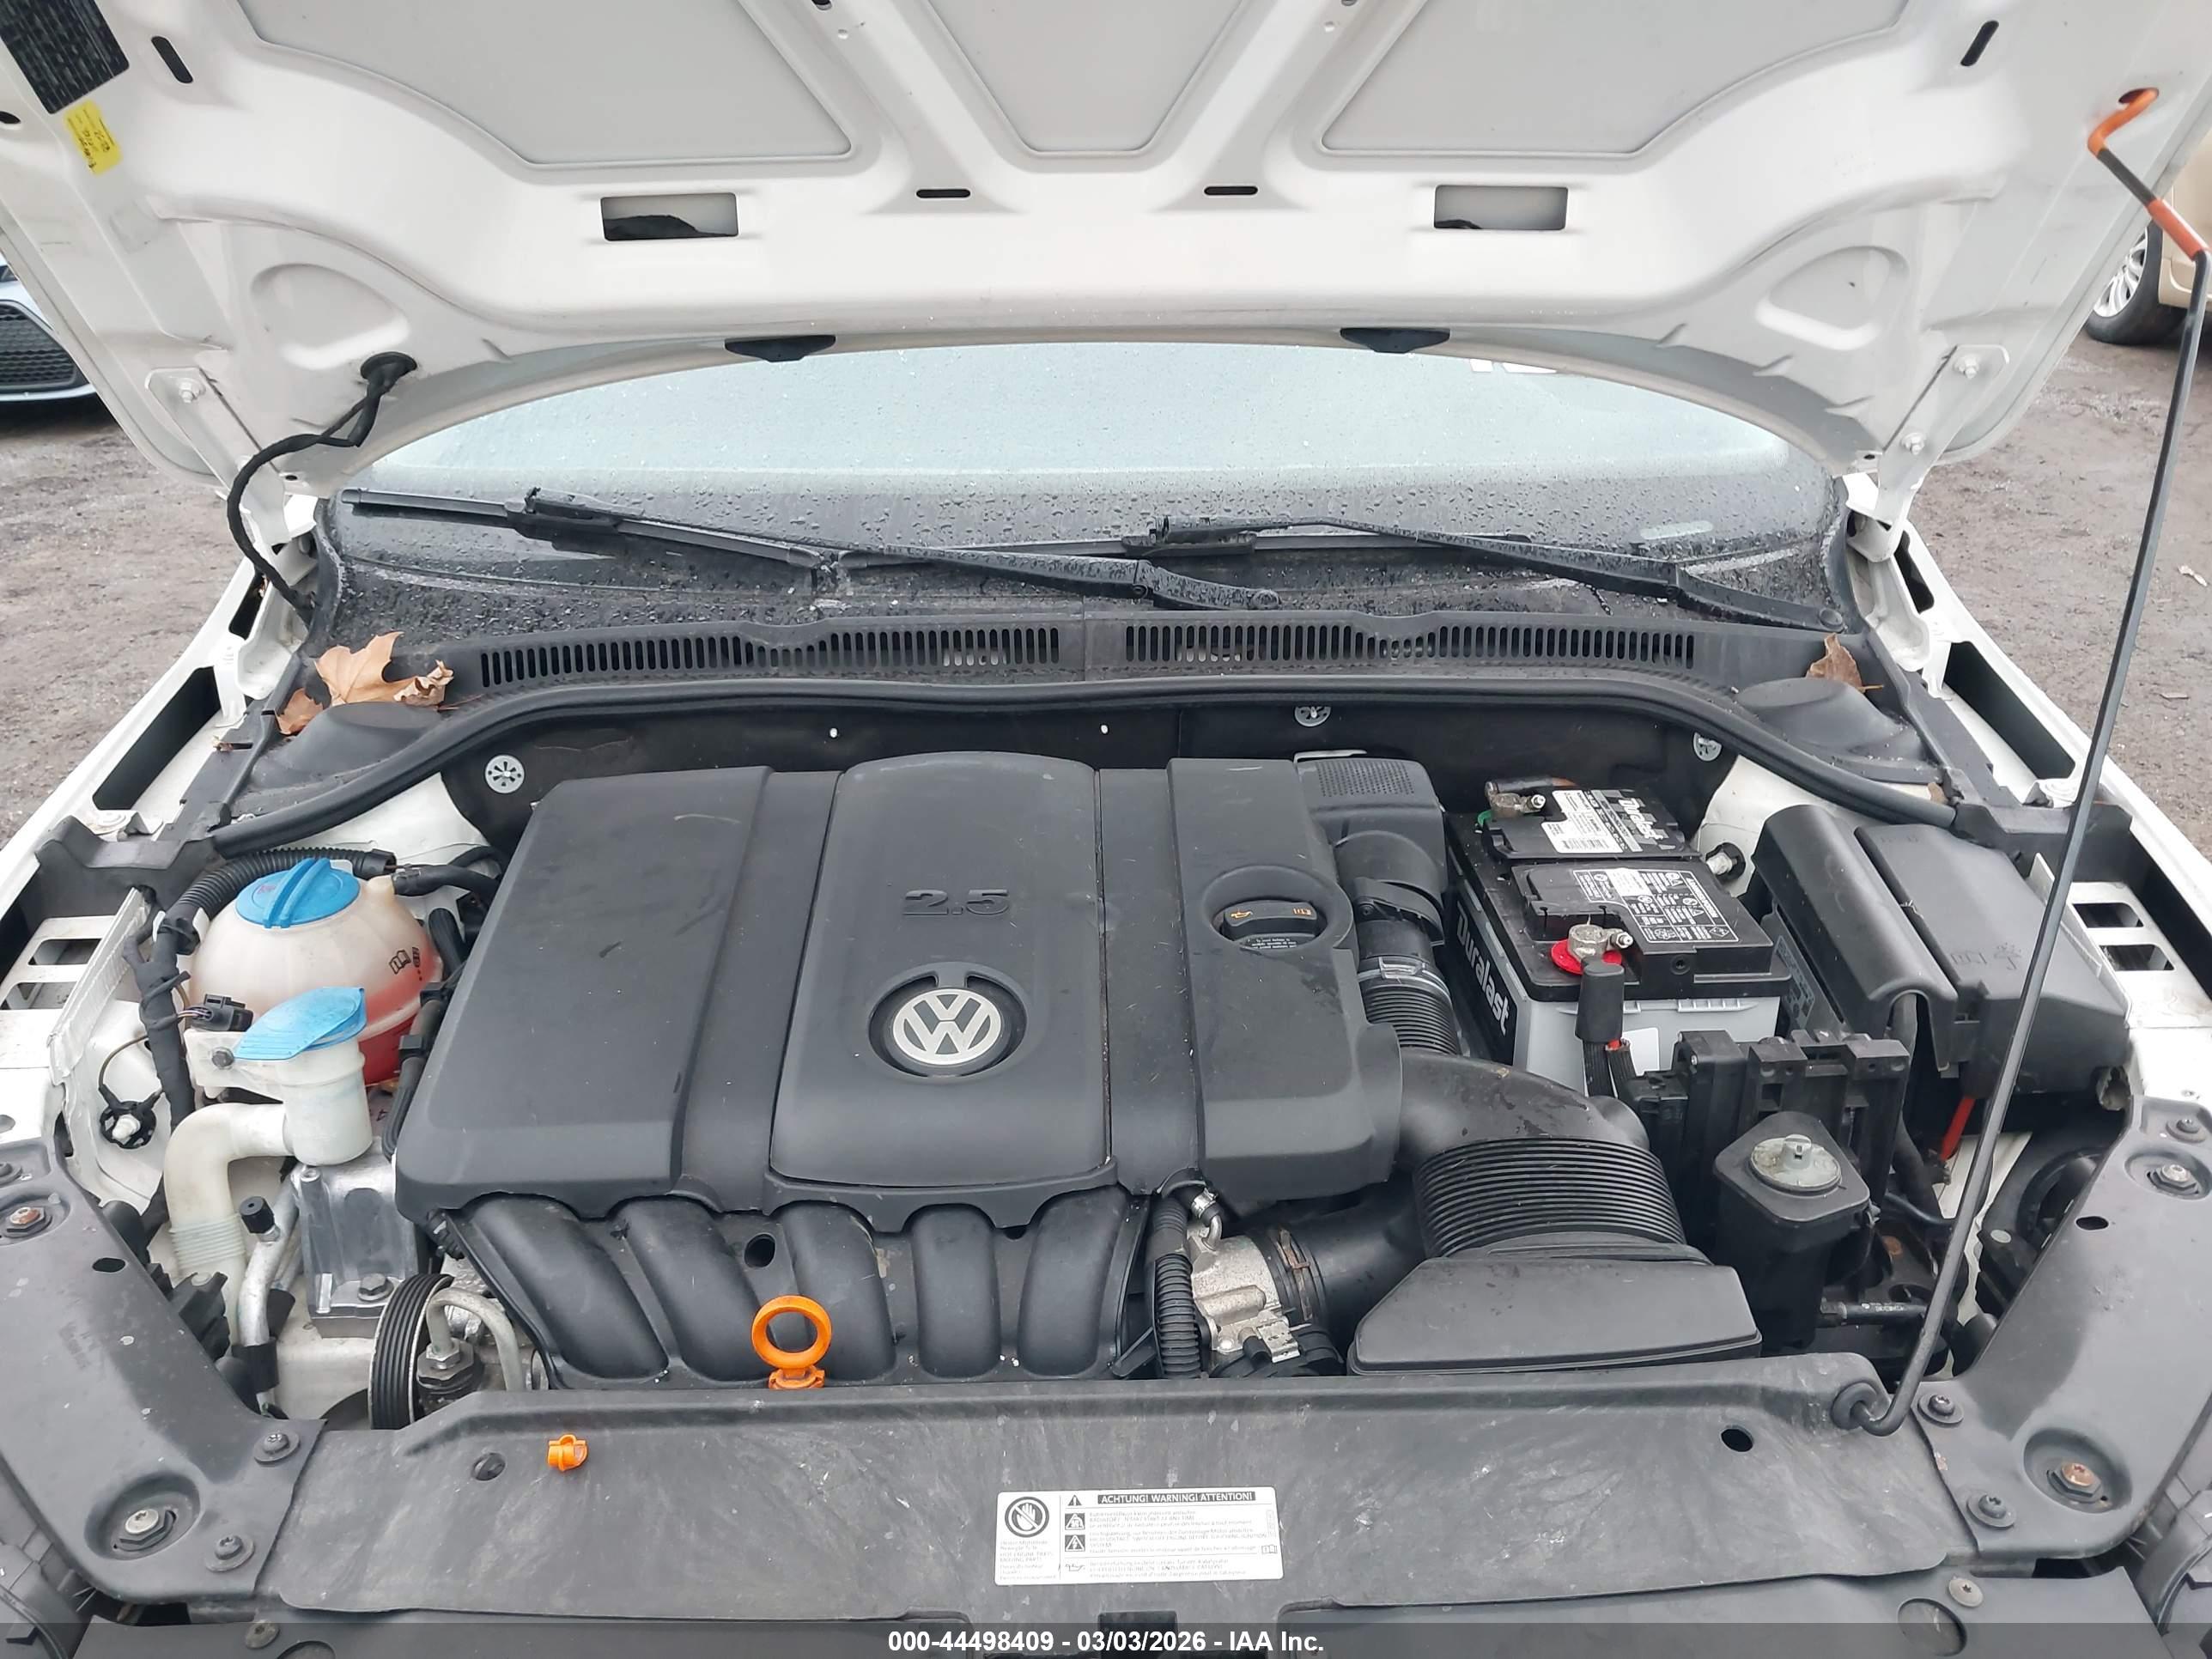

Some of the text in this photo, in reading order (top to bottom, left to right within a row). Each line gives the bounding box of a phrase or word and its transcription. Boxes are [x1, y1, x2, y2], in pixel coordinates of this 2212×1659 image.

[902, 889, 1009, 915] 2.5
[1456, 902, 1510, 1036] Duralast
[1101, 1491, 1254, 1504] ACHTUNG! WARNING! ATTENTION!
